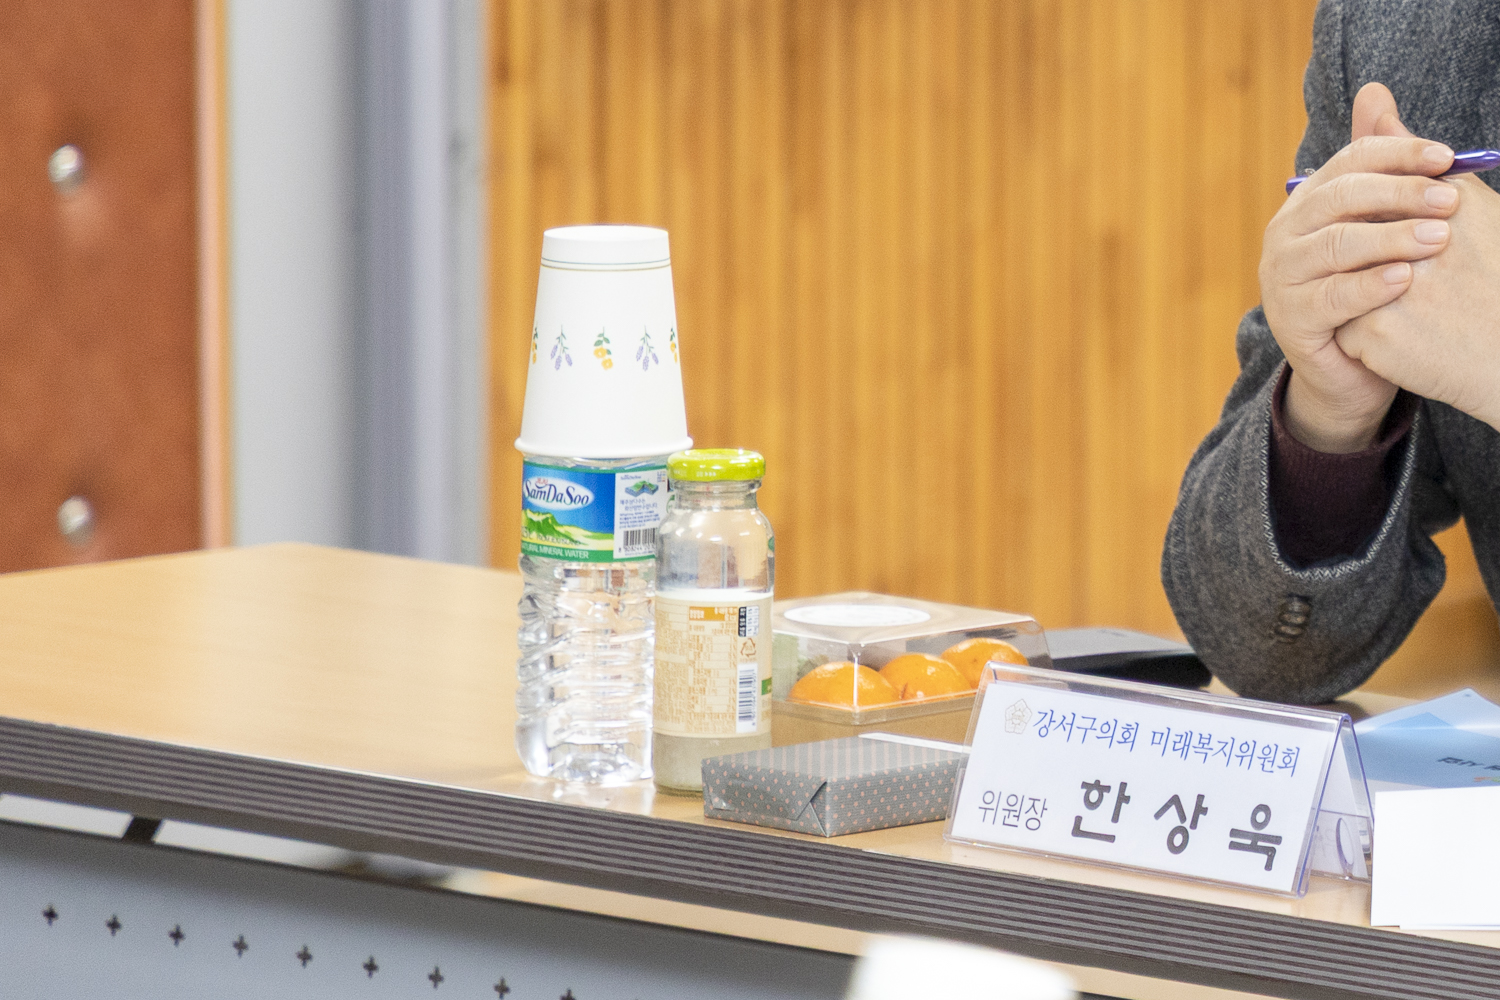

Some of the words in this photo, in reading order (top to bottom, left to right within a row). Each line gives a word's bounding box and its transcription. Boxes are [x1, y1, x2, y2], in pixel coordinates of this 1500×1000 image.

[524, 480, 590, 506] SamDaSoo
[564, 550, 590, 559] WATER
[1033, 709, 1139, 752] 강서구의회
[1150, 728, 1301, 778] 미래복지위원회
[978, 790, 1048, 831] 위원장
